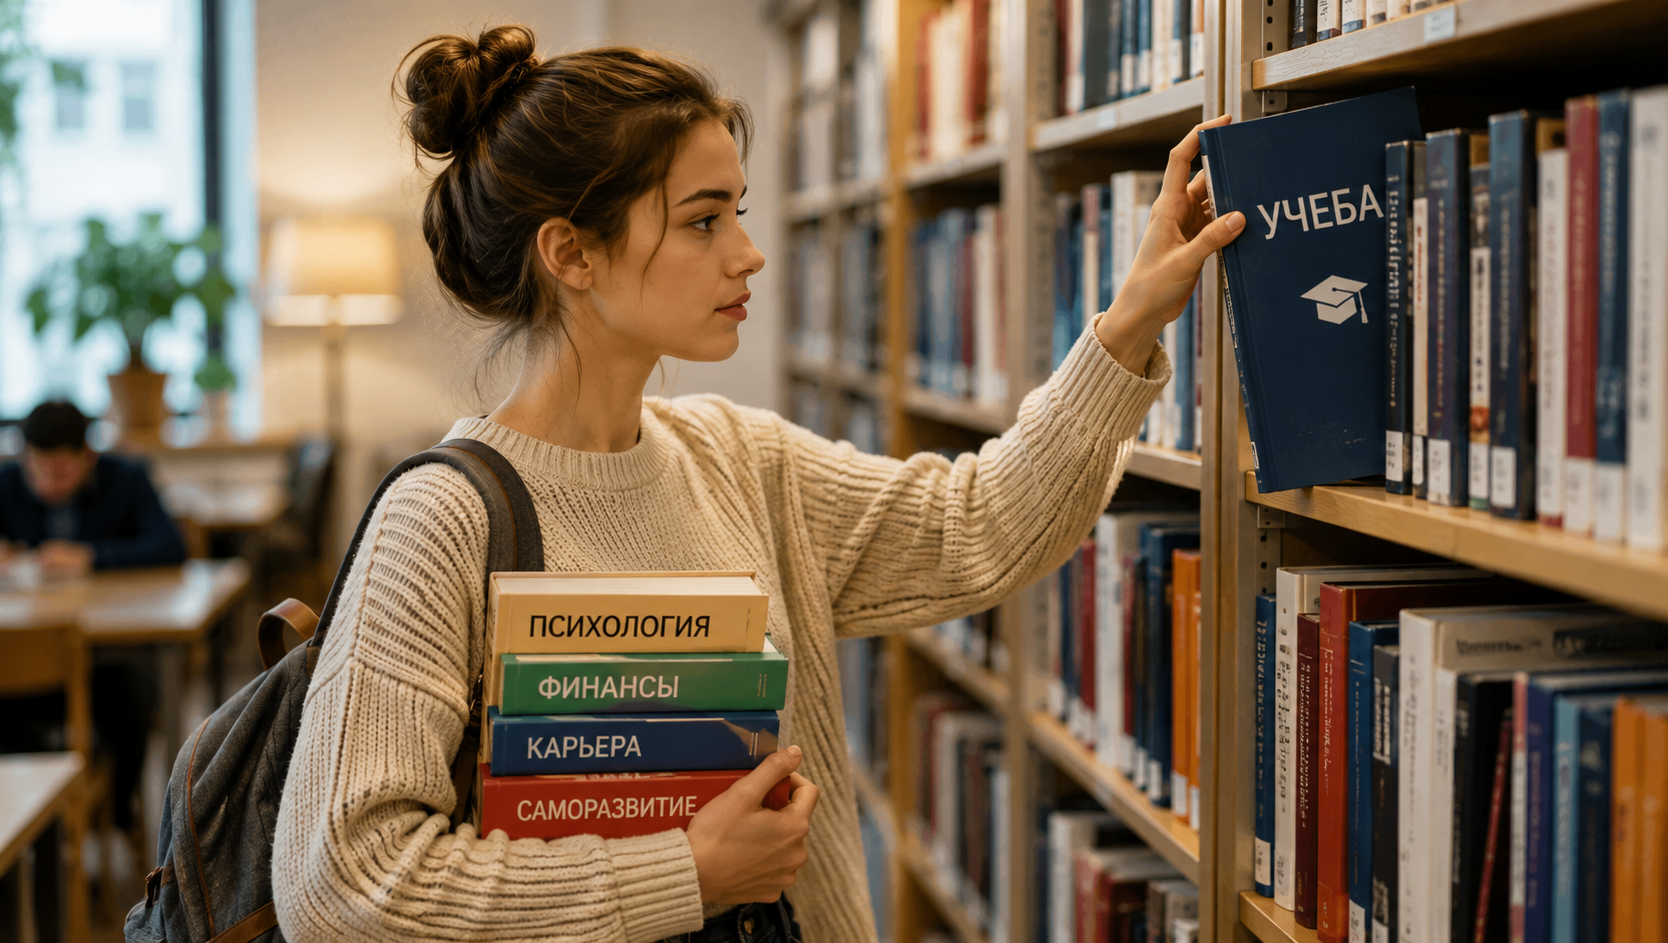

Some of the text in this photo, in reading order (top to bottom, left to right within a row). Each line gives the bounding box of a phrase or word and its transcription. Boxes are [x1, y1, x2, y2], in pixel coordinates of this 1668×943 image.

[1257, 184, 1384, 240] УЧЕБА
[529, 615, 711, 638] ПСИХОЛОГИЯ
[538, 675, 679, 700] ФИНАНСЫ
[527, 735, 642, 759] КАРЬЕРА
[517, 796, 697, 821] САМОРАЗВИТИЕ
